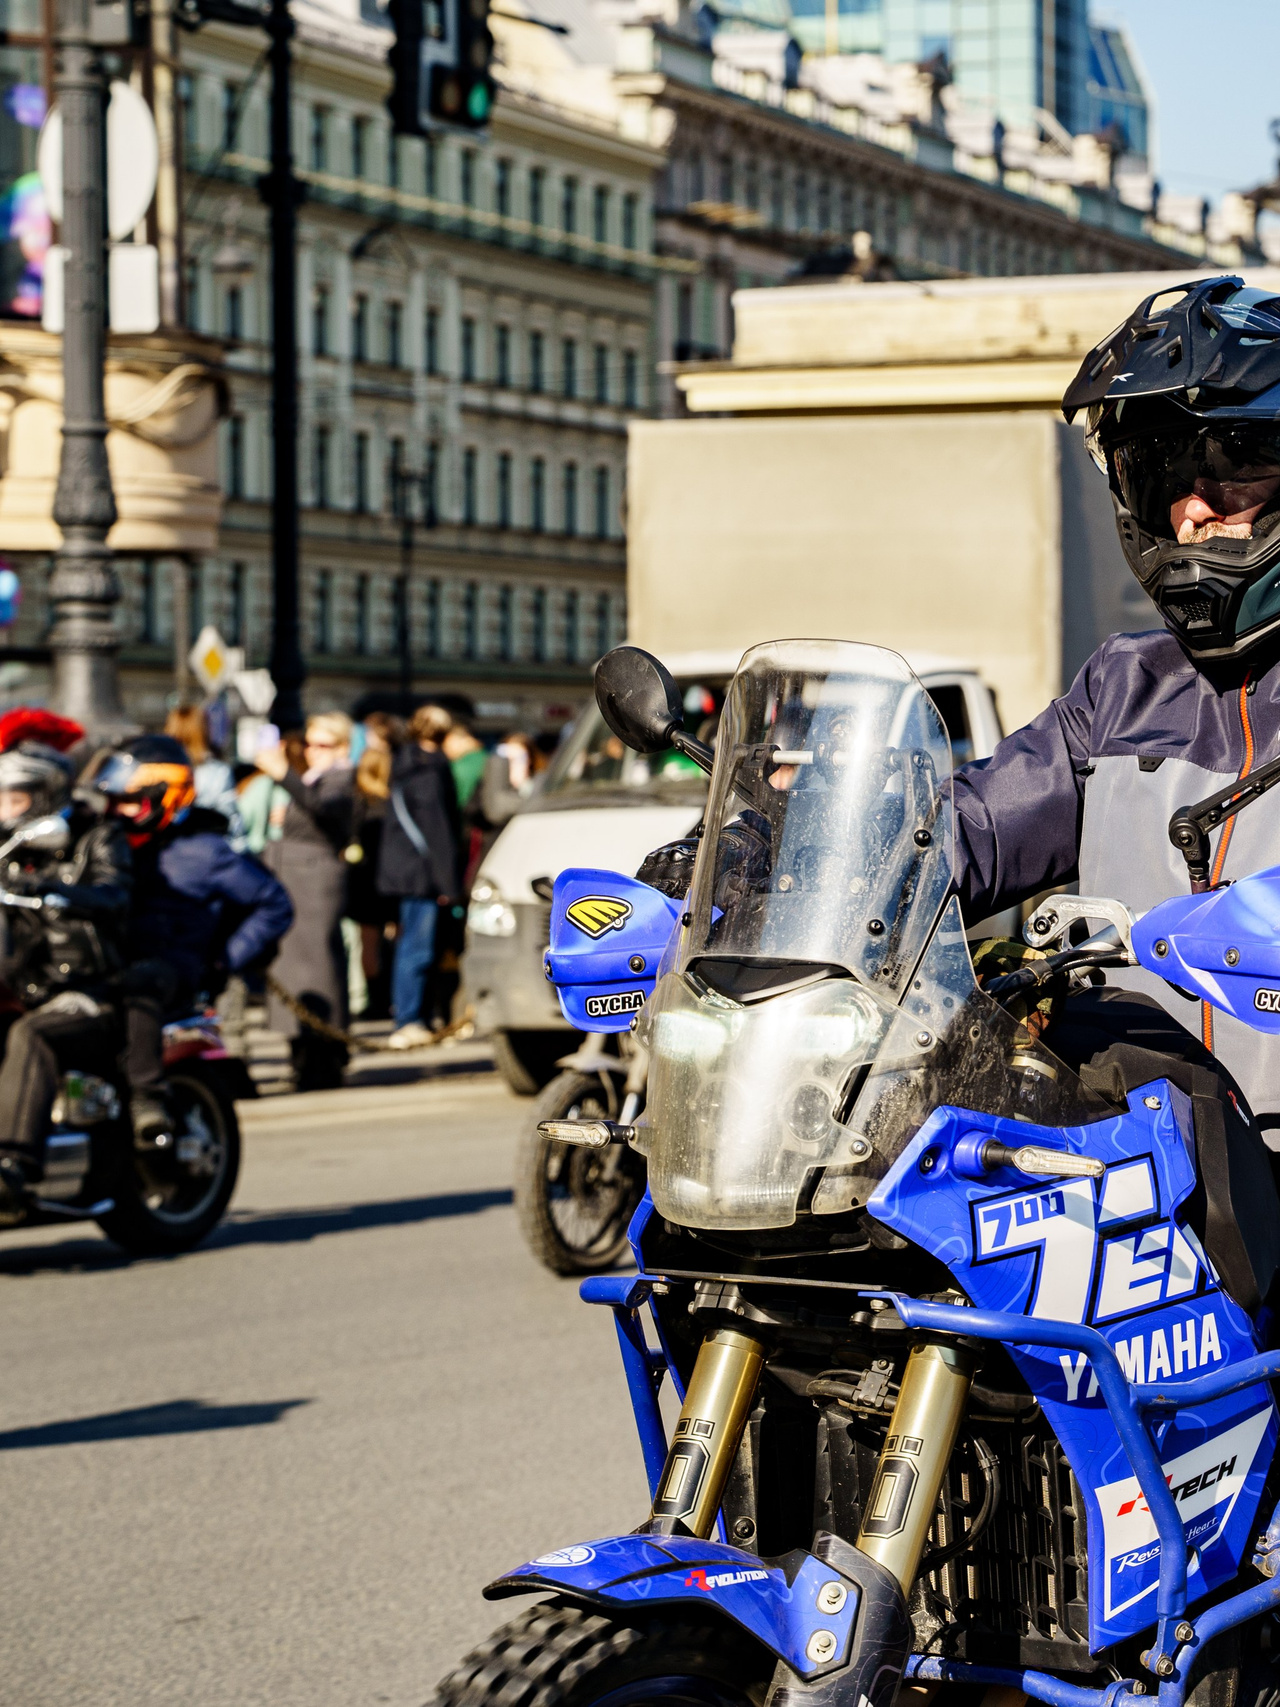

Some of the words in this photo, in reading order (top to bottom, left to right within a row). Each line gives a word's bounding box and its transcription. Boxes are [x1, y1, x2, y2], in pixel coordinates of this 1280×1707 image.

[587, 991, 645, 1016] CYCRA
[983, 1190, 1066, 1248] 700
[1116, 1545, 1162, 1574] Revs
[1188, 1516, 1218, 1539] Heart
